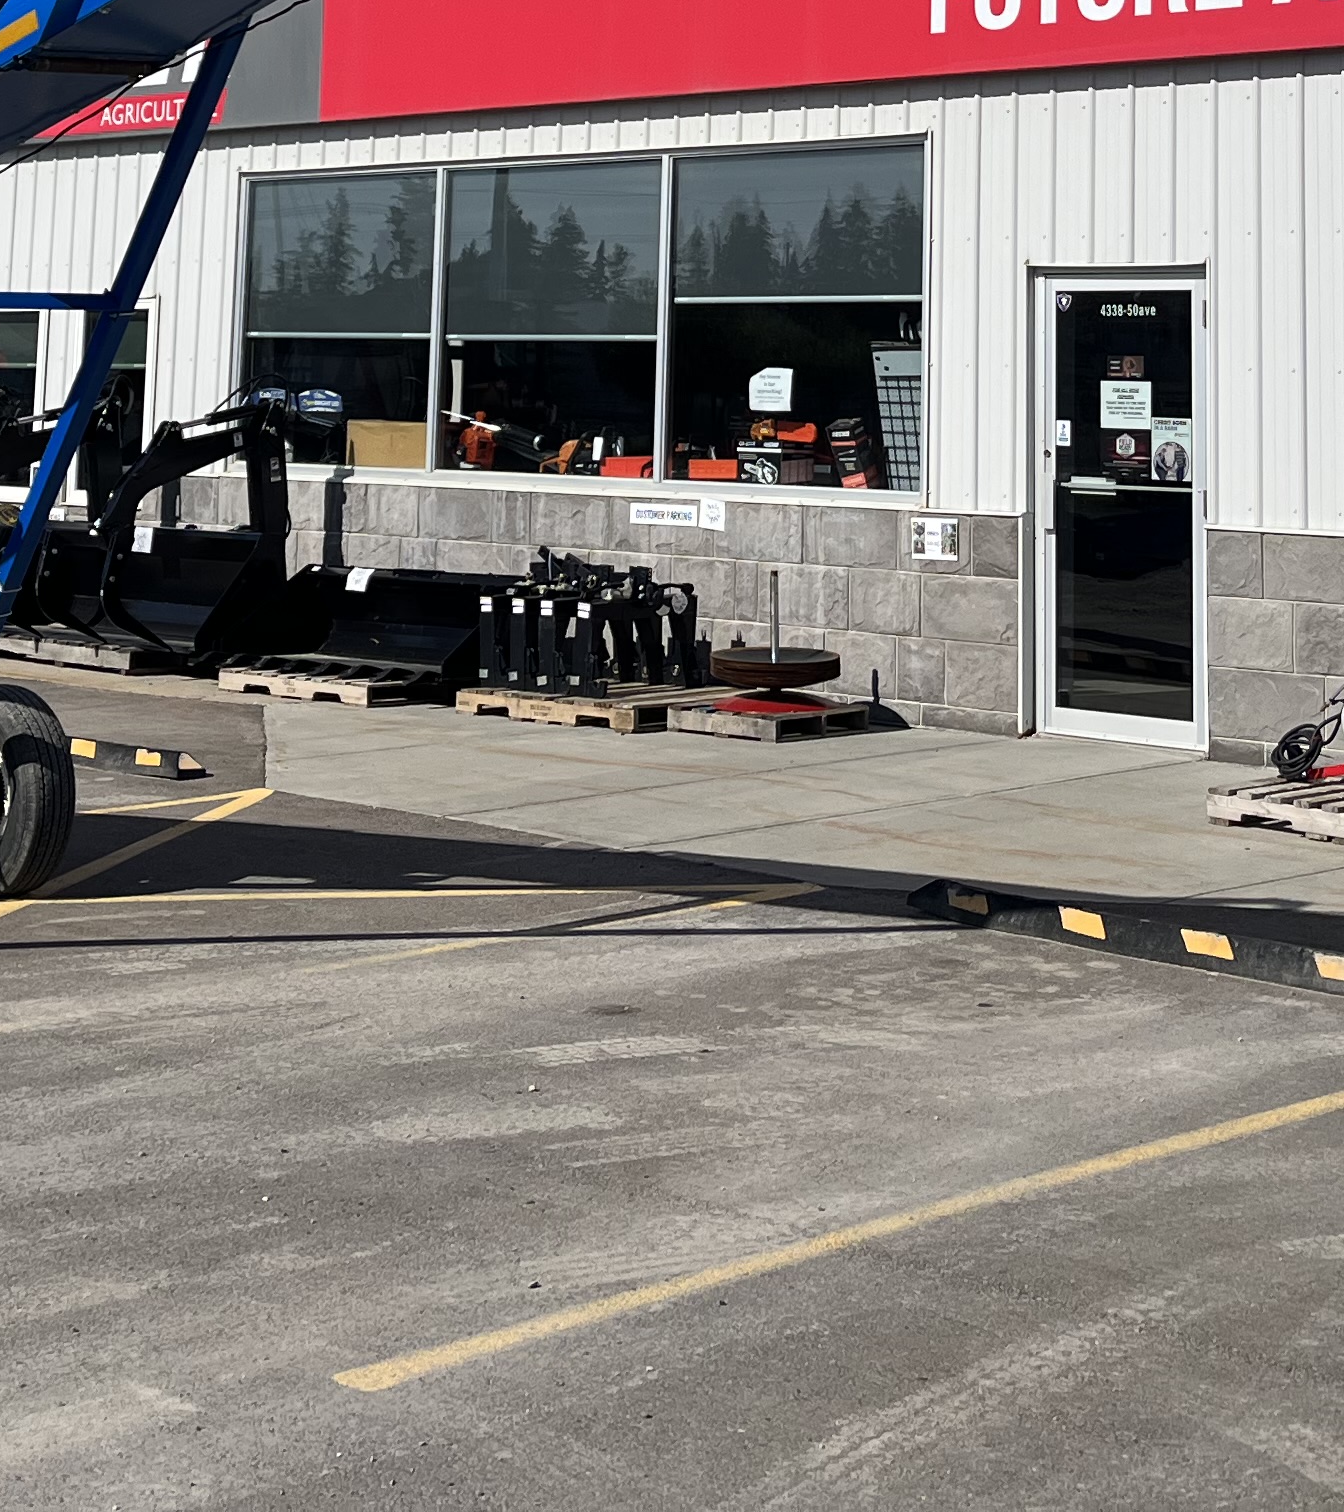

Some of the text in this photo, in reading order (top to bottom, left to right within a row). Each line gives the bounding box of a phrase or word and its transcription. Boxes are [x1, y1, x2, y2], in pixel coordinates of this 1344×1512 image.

[100, 97, 217, 126] AGRICULT
[1100, 303, 1156, 317] 4338-50ave
[636, 509, 665, 520] CUSTOMER
[667, 510, 693, 521] PARKING
